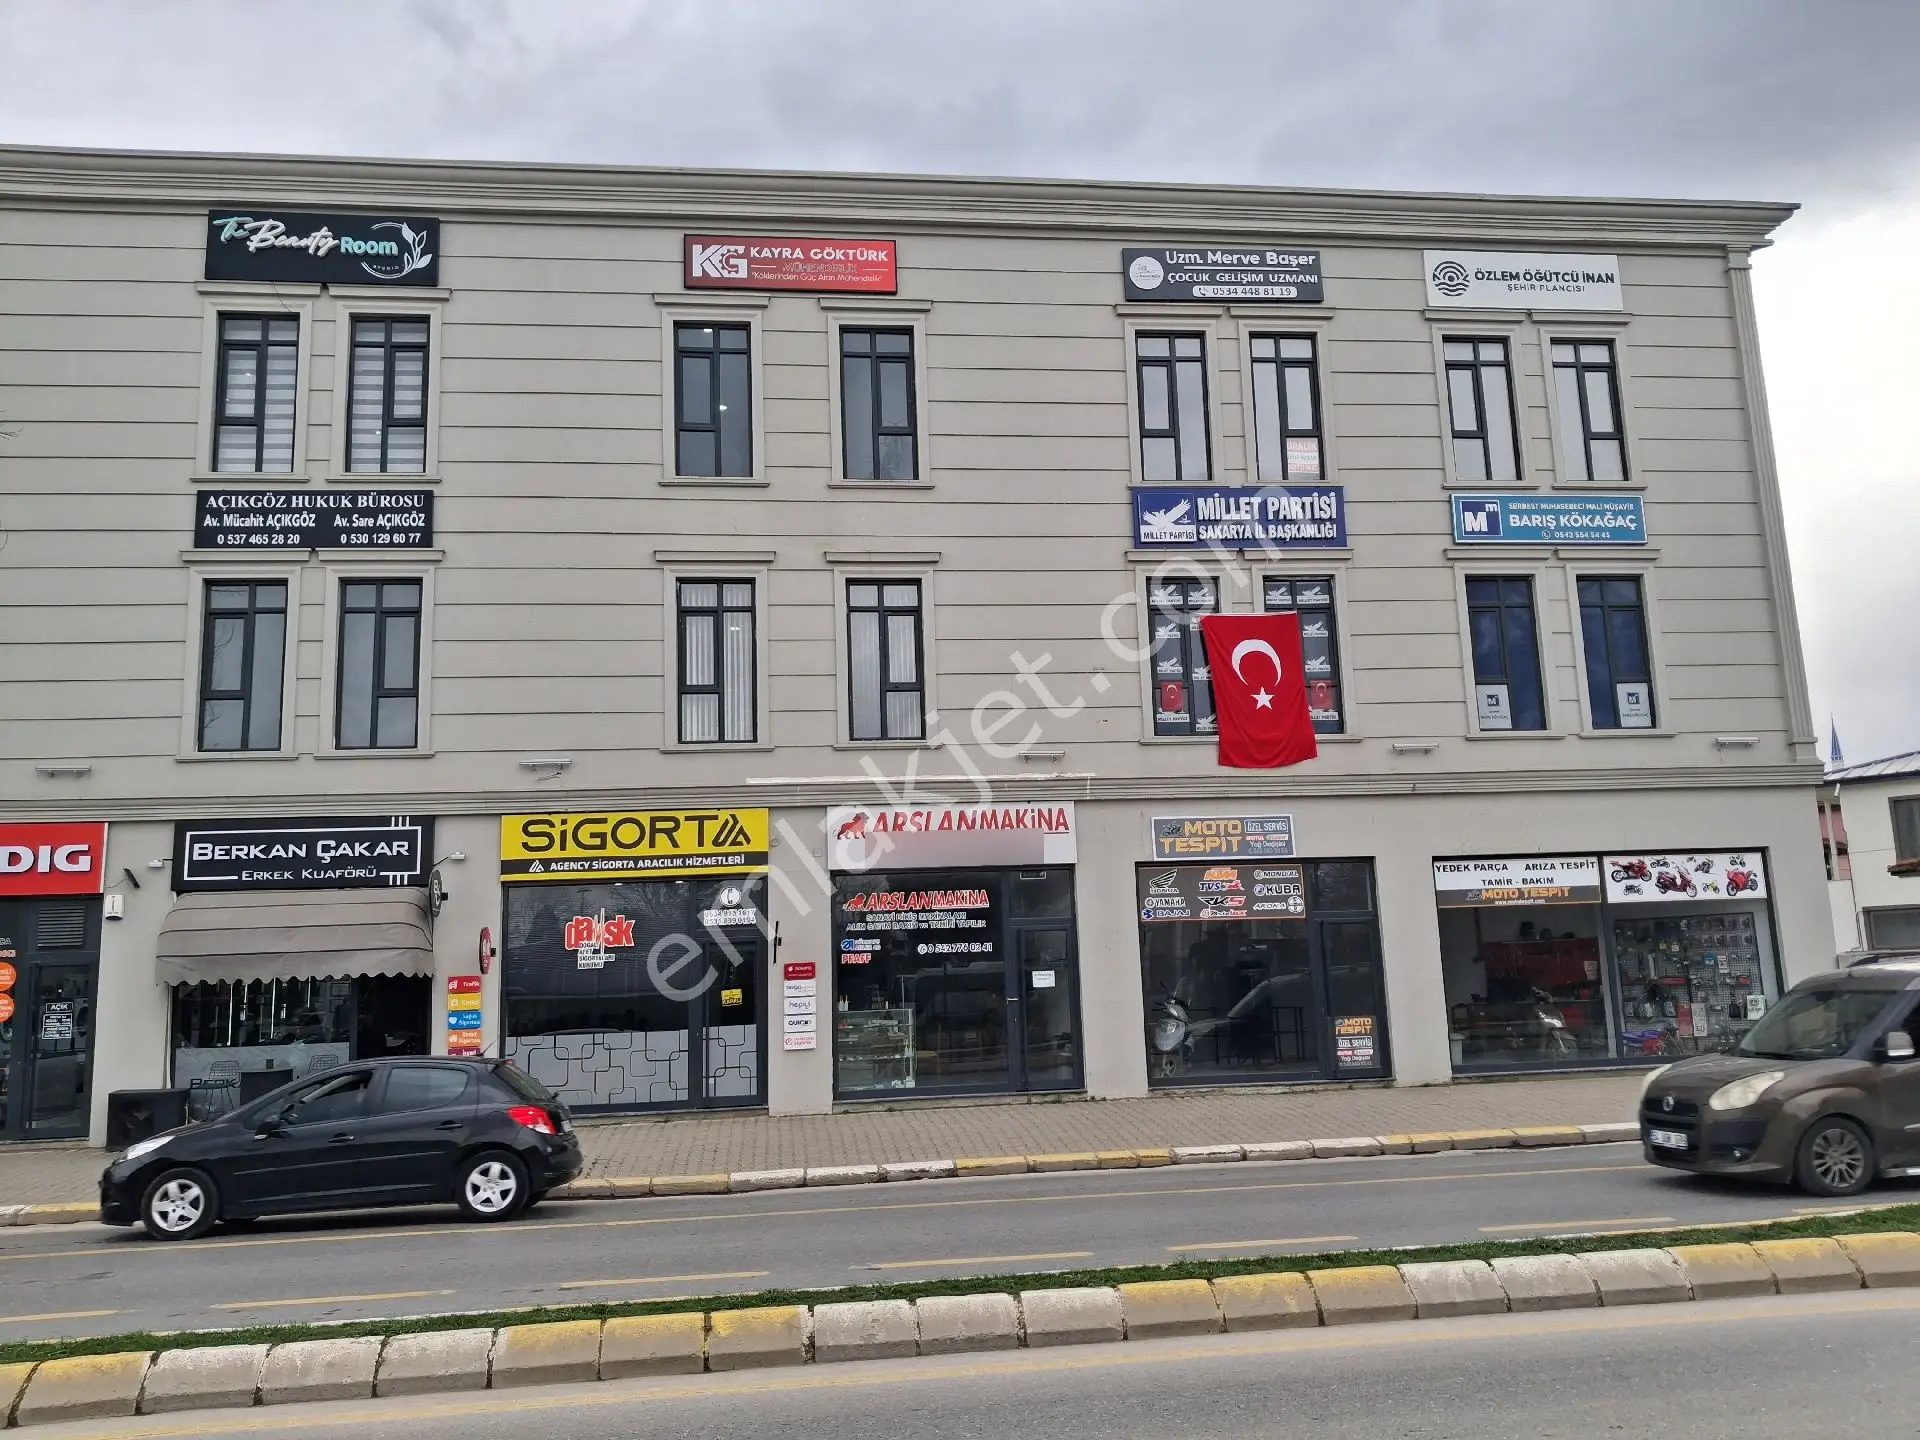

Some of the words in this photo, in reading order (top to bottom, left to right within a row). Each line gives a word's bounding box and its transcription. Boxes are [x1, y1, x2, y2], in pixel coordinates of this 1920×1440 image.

[244, 219, 340, 258] Beauty
[341, 237, 398, 256] Room
[751, 246, 805, 260] KAYRA
[810, 247, 889, 262] GÖKTÜRK
[1166, 251, 1203, 265] Uzm.
[1207, 251, 1260, 265] Merve
[1266, 252, 1316, 267] Başer
[1168, 272, 1211, 284] ÇOCUK
[1216, 272, 1264, 285] GELİŞİM
[1269, 274, 1318, 284] UZMANI
[1475, 268, 1520, 282] ÖZLEM
[1523, 269, 1580, 283] ÖĞÜTCÜ
[1582, 270, 1616, 284] İNAN
[1212, 286, 1238, 296] 0534
[1241, 286, 1260, 296] 448
[1263, 286, 1275, 296] 81
[1279, 286, 1291, 296] 19
[1507, 283, 1536, 293] ŞEHİR
[1539, 284, 1585, 293] PLANCISI
[205, 492, 287, 511] AÇIKGÖZ
[291, 495, 353, 509] HUKUK
[357, 492, 425, 509] BÜROSU
[1197, 492, 1261, 521] MİLLET
[1267, 491, 1337, 520] PARTİSİ
[1508, 502, 1539, 510] SERBEST
[203, 515, 220, 527] Av.
[223, 513, 264, 527] Mücahit
[266, 513, 315, 530] AÇIKGÖZ
[334, 515, 350, 527] Av.
[352, 515, 374, 527] Sare
[376, 512, 425, 530] AÇIKGÖZ
[1509, 514, 1557, 529] BARIŞ
[1560, 511, 1637, 531] KÖKAĞAÇ
[340, 533, 347, 544] 0
[350, 533, 369, 544] 530
[372, 533, 391, 544] 129
[393, 533, 406, 544] 60
[408, 533, 421, 544] 77
[1169, 529, 1195, 540] PARTİSİ
[1199, 524, 1253, 540] SAKARYA
[1254, 521, 1266, 540] İL
[1268, 522, 1337, 542] BAŞKANLIĞI
[217, 534, 224, 545] 0
[227, 534, 247, 545] 537
[249, 534, 269, 545] 465
[272, 534, 285, 545] 28
[287, 534, 300, 545] 20
[1184, 819, 1242, 837] MOTO
[192, 842, 306, 861] BERKAN
[316, 839, 410, 864] ÇAKAR
[550, 860, 590, 871] AGENCY
[592, 858, 635, 870] SİGORTA
[636, 857, 683, 869] ARACILIK
[685, 853, 745, 867] HİZMETLERİ
[1435, 864, 1471, 873] YEDEK
[1473, 863, 1508, 874] PARÇA
[1524, 861, 1556, 871] ARIZA
[1560, 860, 1596, 870] TESPİT
[241, 869, 294, 881] ERKEK
[301, 865, 376, 880] KUAFÖRÜ
[1199, 881, 1222, 892] TVS
[1481, 876, 1513, 887] TAMİR
[1521, 877, 1555, 886] BAKIM
[1266, 884, 1300, 896] KUBA
[1481, 888, 1519, 900] MOTO
[1155, 897, 1186, 908] YAMAHA
[1156, 909, 1191, 917] BAJAJ
